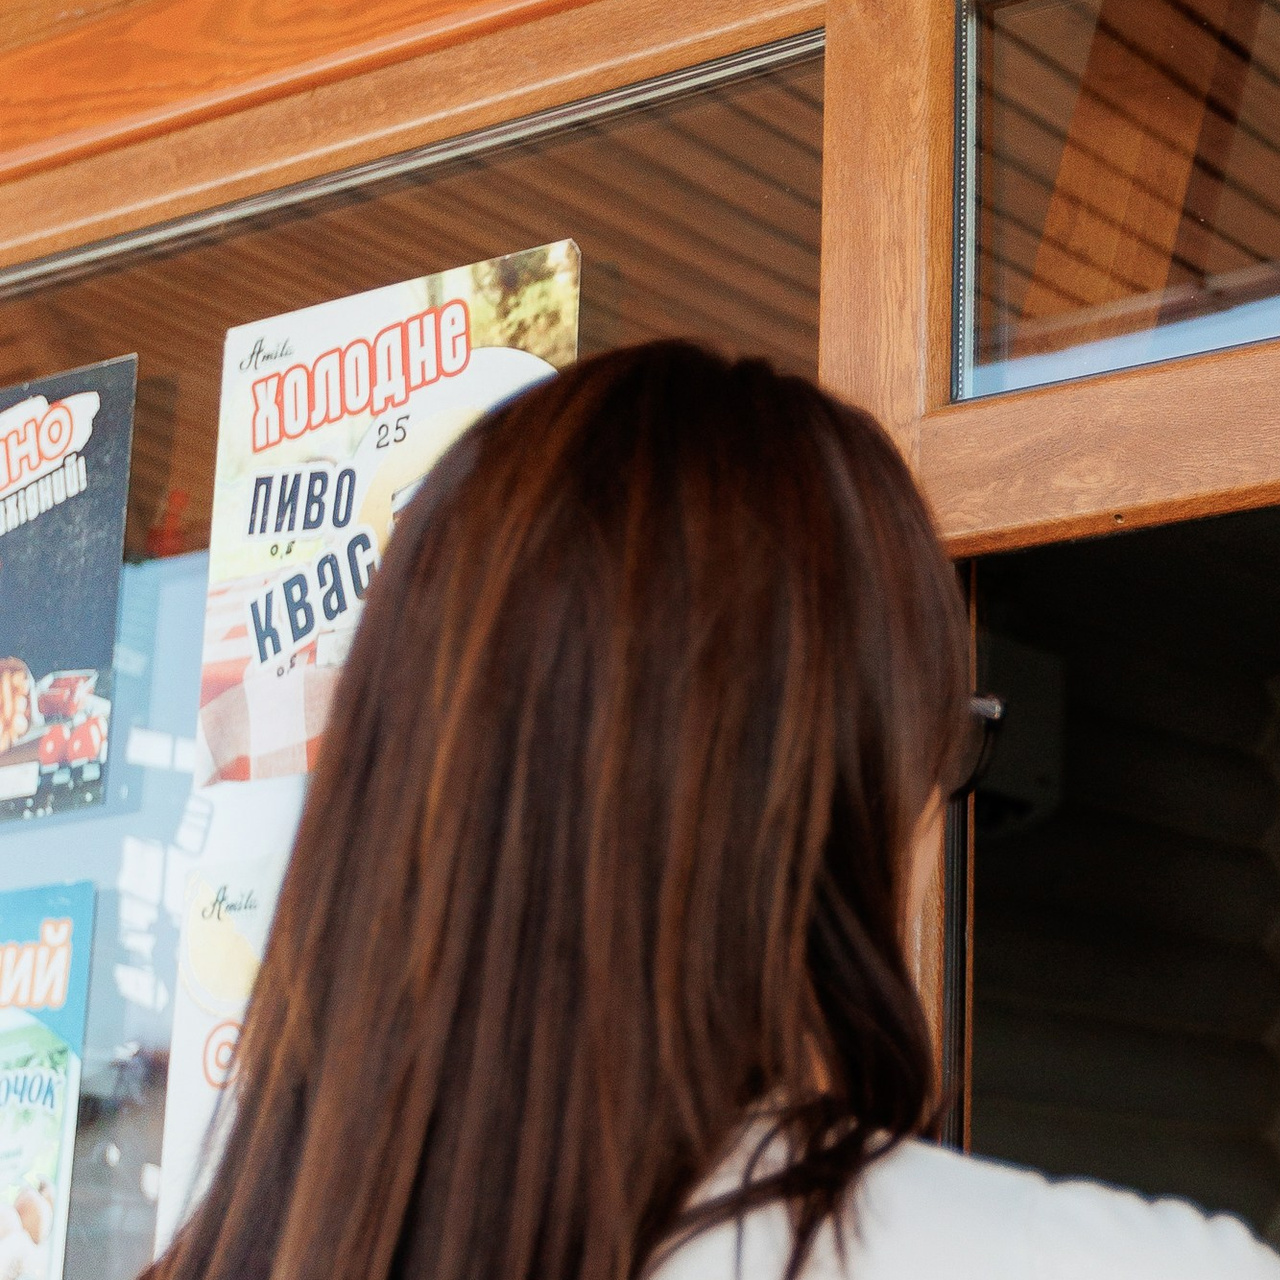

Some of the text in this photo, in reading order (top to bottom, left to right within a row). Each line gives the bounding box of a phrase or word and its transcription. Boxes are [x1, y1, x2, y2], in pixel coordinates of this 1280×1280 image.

[252, 299, 471, 454] ХОЛОДНЕ
[376, 415, 410, 449] 25
[248, 468, 356, 535] ПИВО
[250, 532, 375, 664] КВАС
